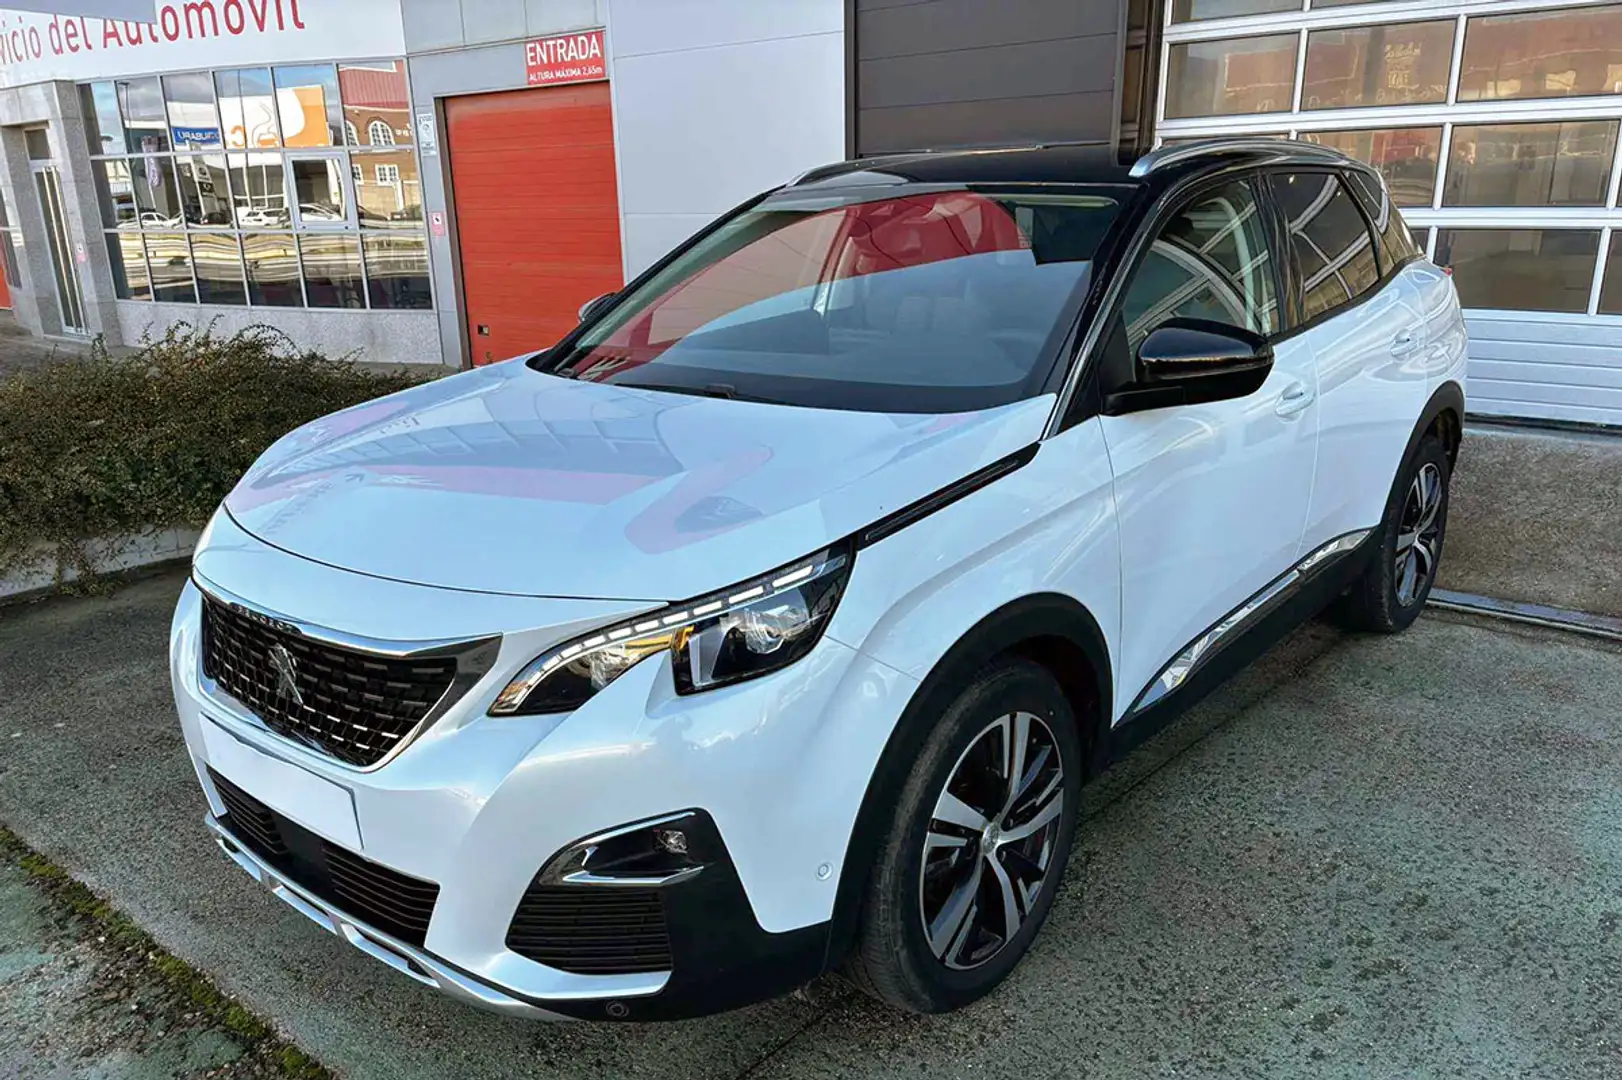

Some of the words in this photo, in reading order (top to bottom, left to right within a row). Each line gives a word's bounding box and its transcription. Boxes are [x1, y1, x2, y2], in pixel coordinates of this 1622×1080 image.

[48, 14, 92, 55] del
[526, 35, 601, 66] ENTRADA
[529, 70, 554, 82] ALTURA
